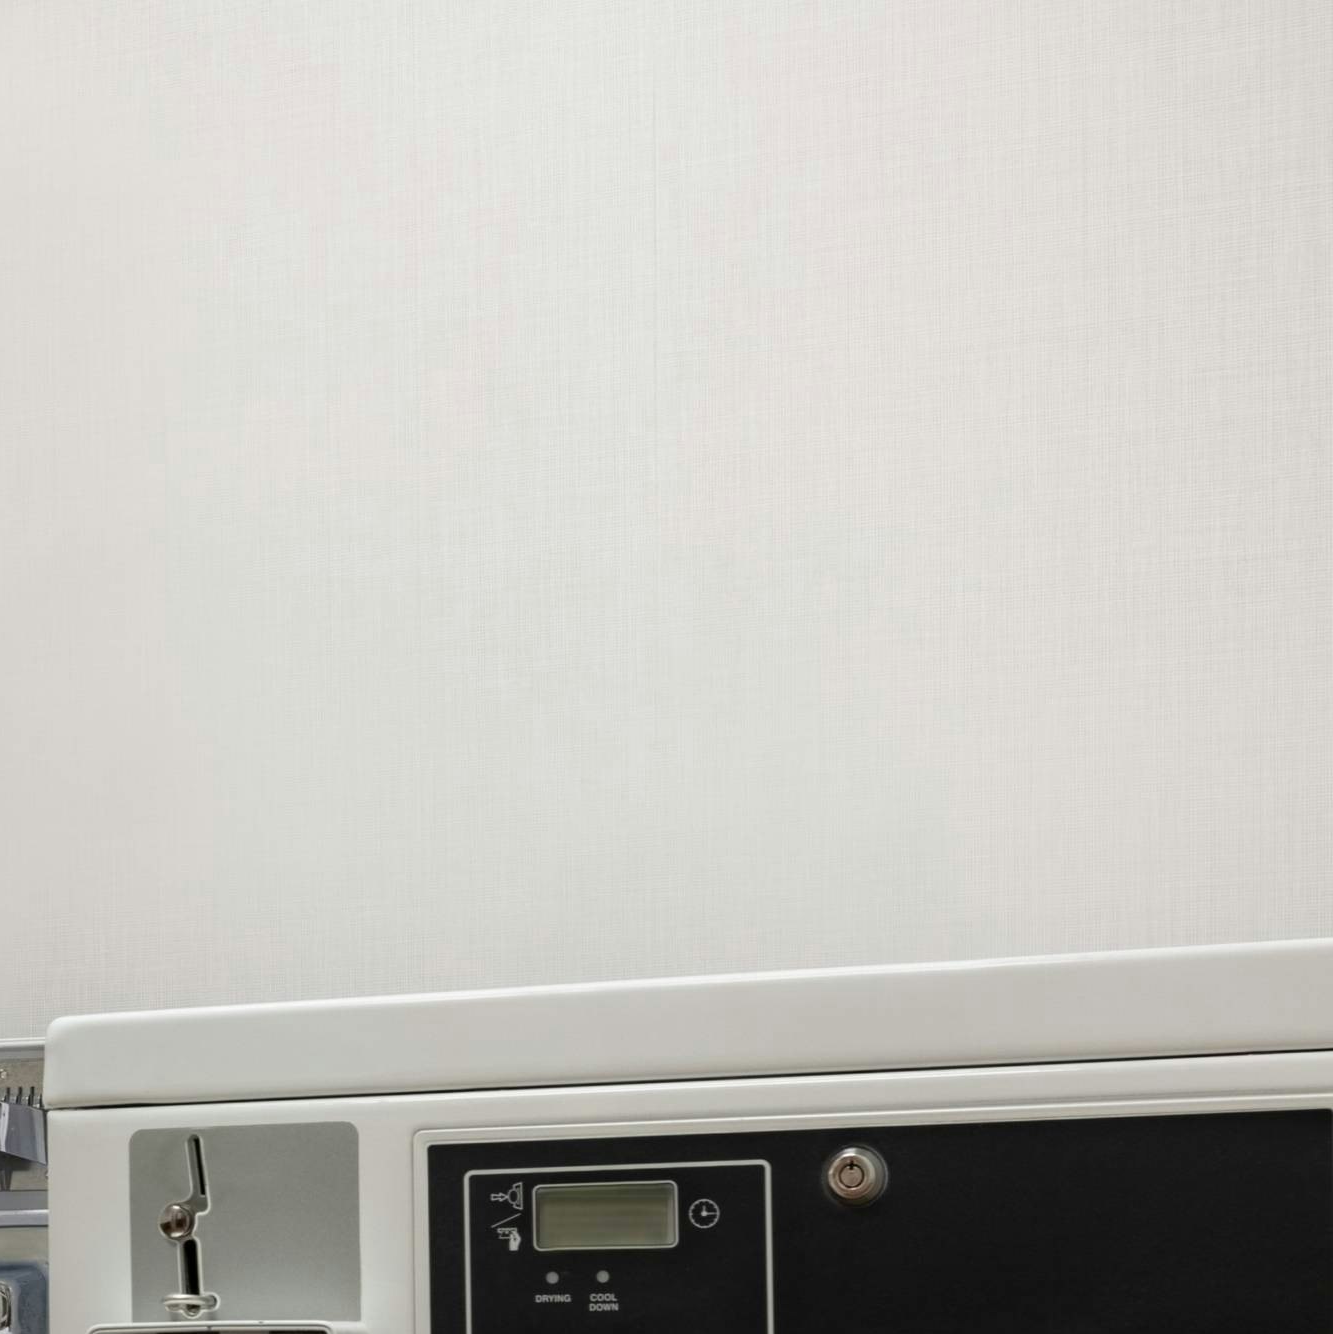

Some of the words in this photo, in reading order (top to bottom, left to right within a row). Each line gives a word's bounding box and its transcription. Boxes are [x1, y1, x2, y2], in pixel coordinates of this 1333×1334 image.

[535, 1294, 572, 1303] DRYING
[590, 1293, 618, 1301] COOL
[589, 1303, 619, 1311] DOWN
